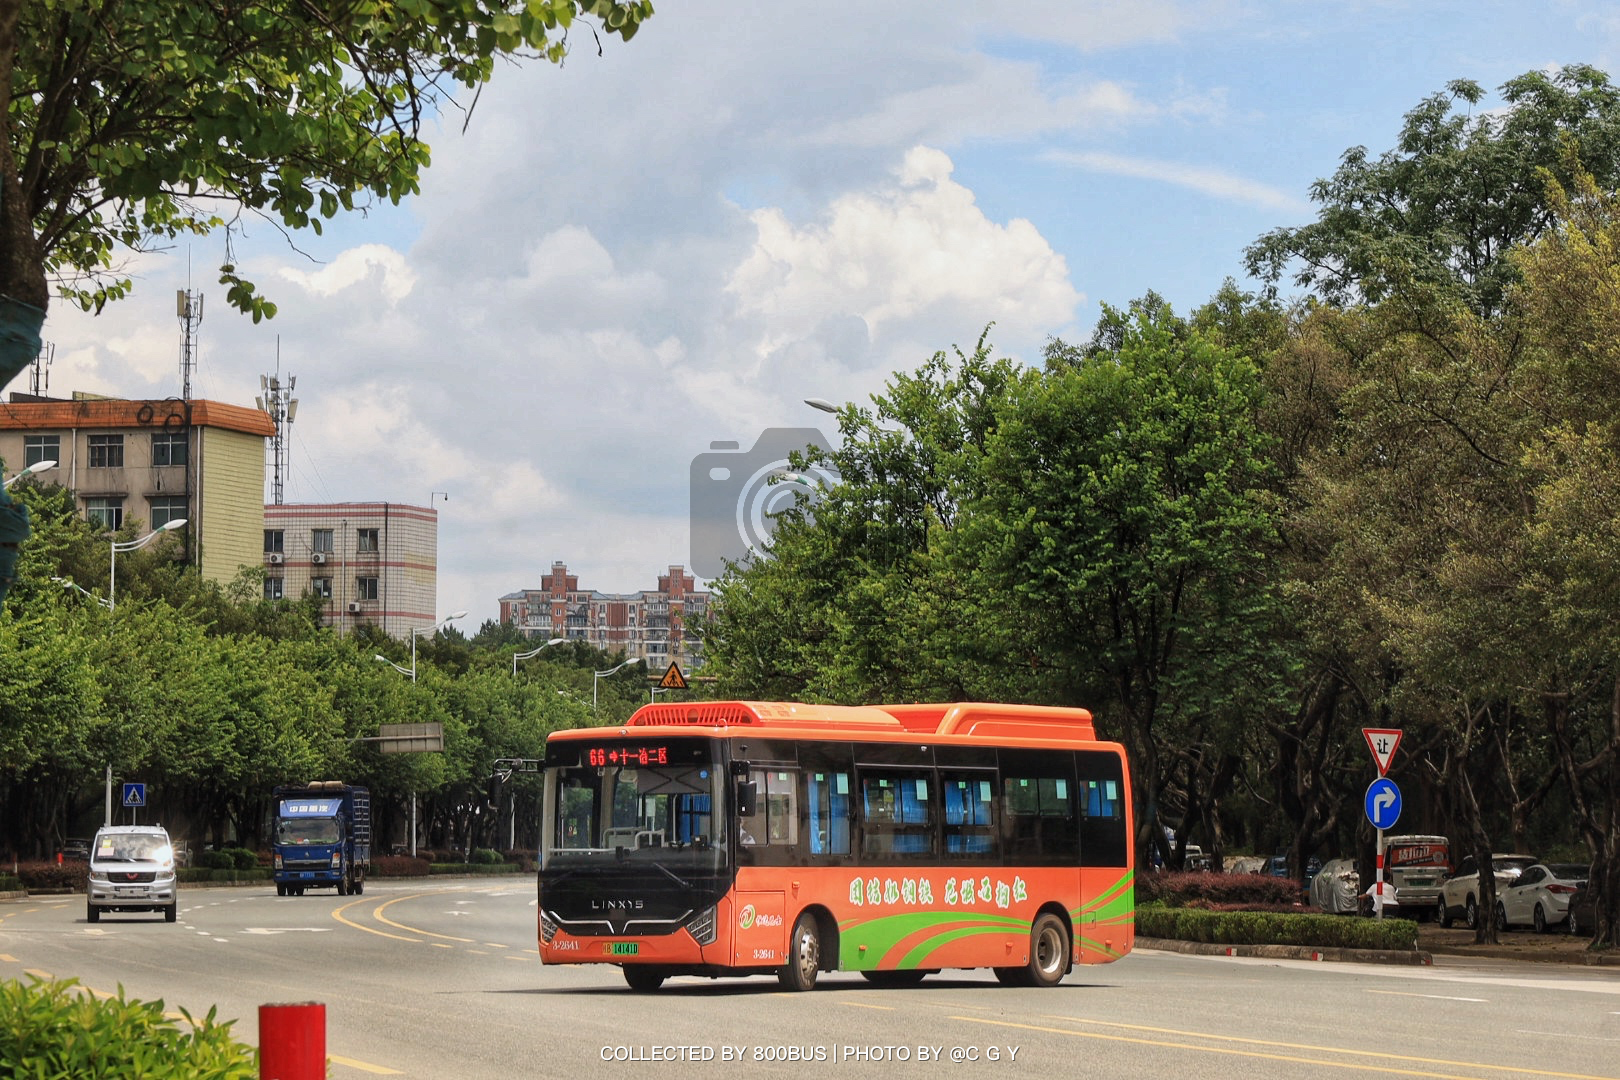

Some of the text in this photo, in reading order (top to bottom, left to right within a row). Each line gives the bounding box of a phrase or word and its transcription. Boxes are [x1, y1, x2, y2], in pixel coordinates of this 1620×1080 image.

[1377, 739, 1389, 755] 让
[589, 747, 668, 766] 66 十一冶二区
[849, 877, 934, 907] 团结如钢铁
[592, 900, 644, 910] LINXYS
[552, 940, 580, 950] 3-2641
[753, 949, 775, 959] 3-2641
